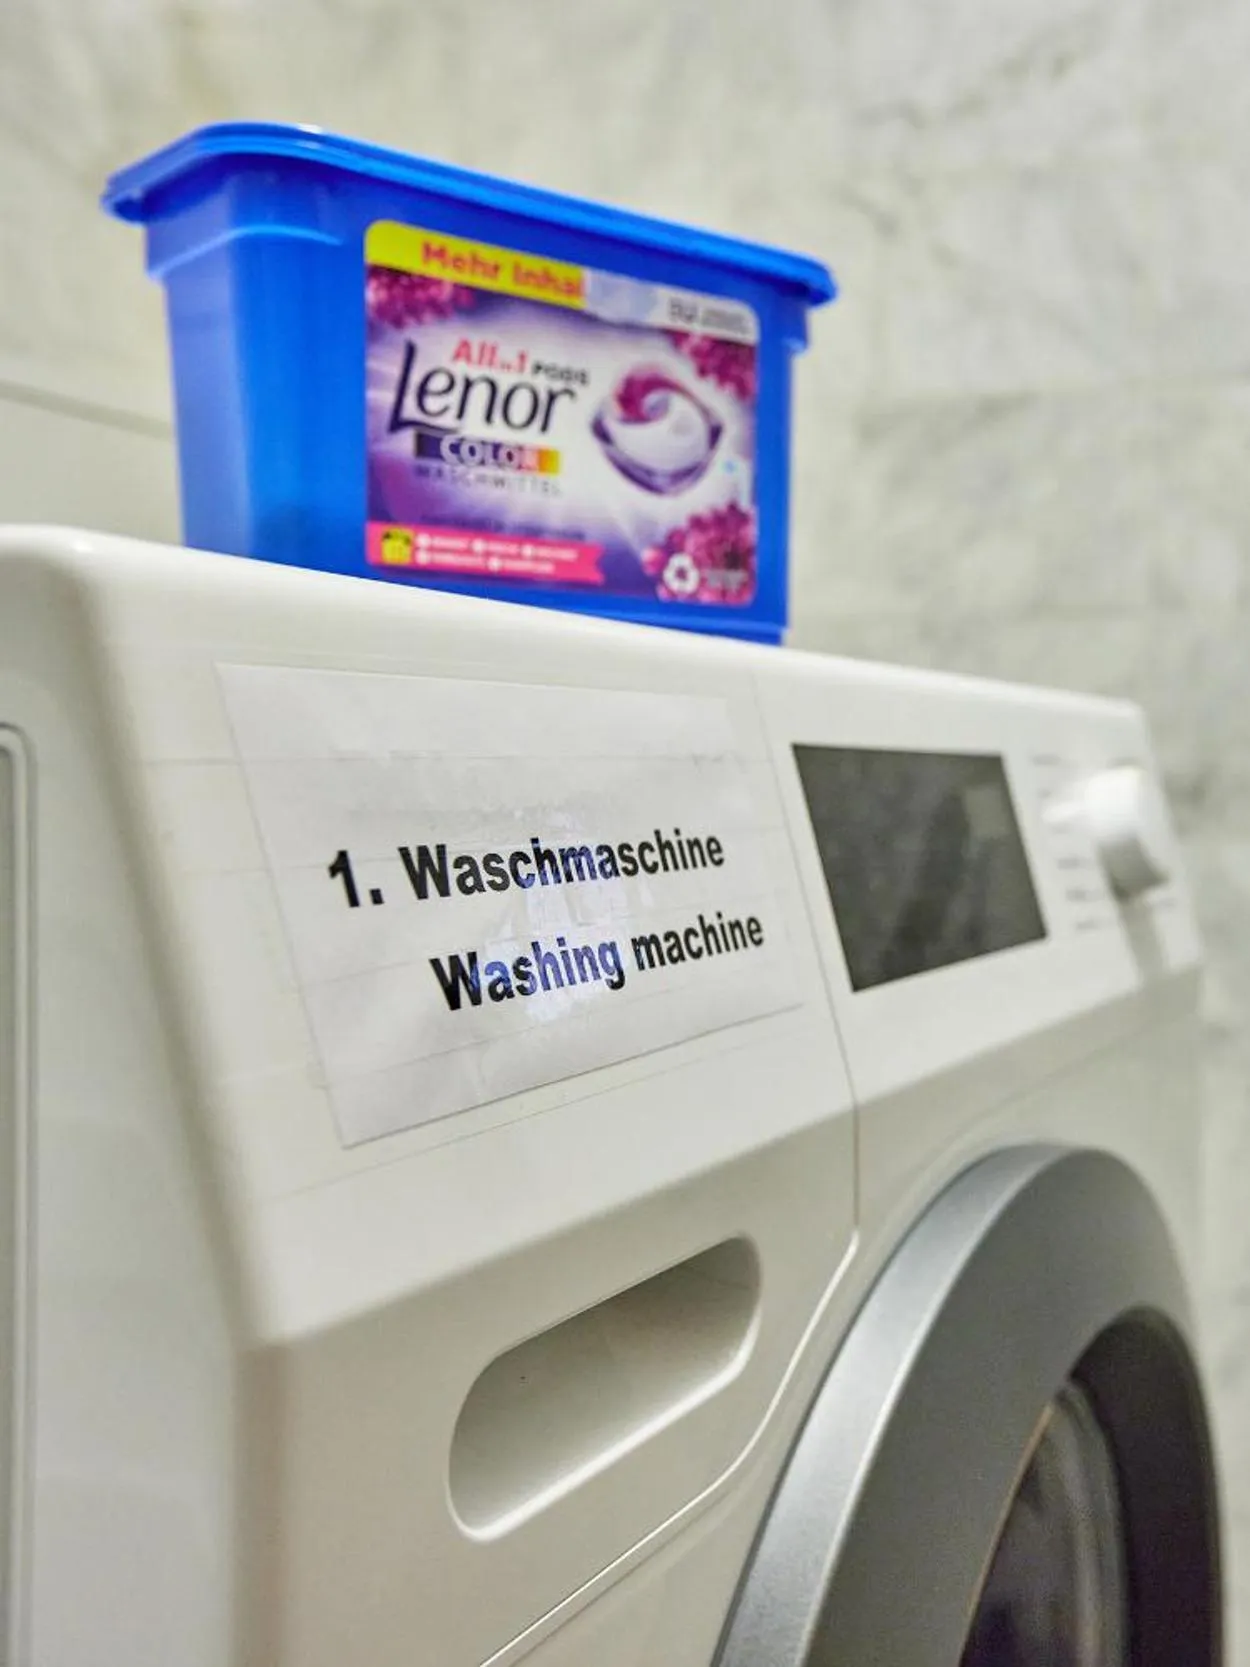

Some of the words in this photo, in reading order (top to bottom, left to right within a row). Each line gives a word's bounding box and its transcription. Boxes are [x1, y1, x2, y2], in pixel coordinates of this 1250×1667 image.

[422, 240, 500, 280] Mehr
[388, 337, 577, 434] Lenor
[439, 434, 541, 473] COLOR
[328, 849, 384, 908] 1.
[397, 827, 725, 901] Waschmaschine
[428, 936, 626, 1011] Washing
[630, 911, 765, 972] machine
